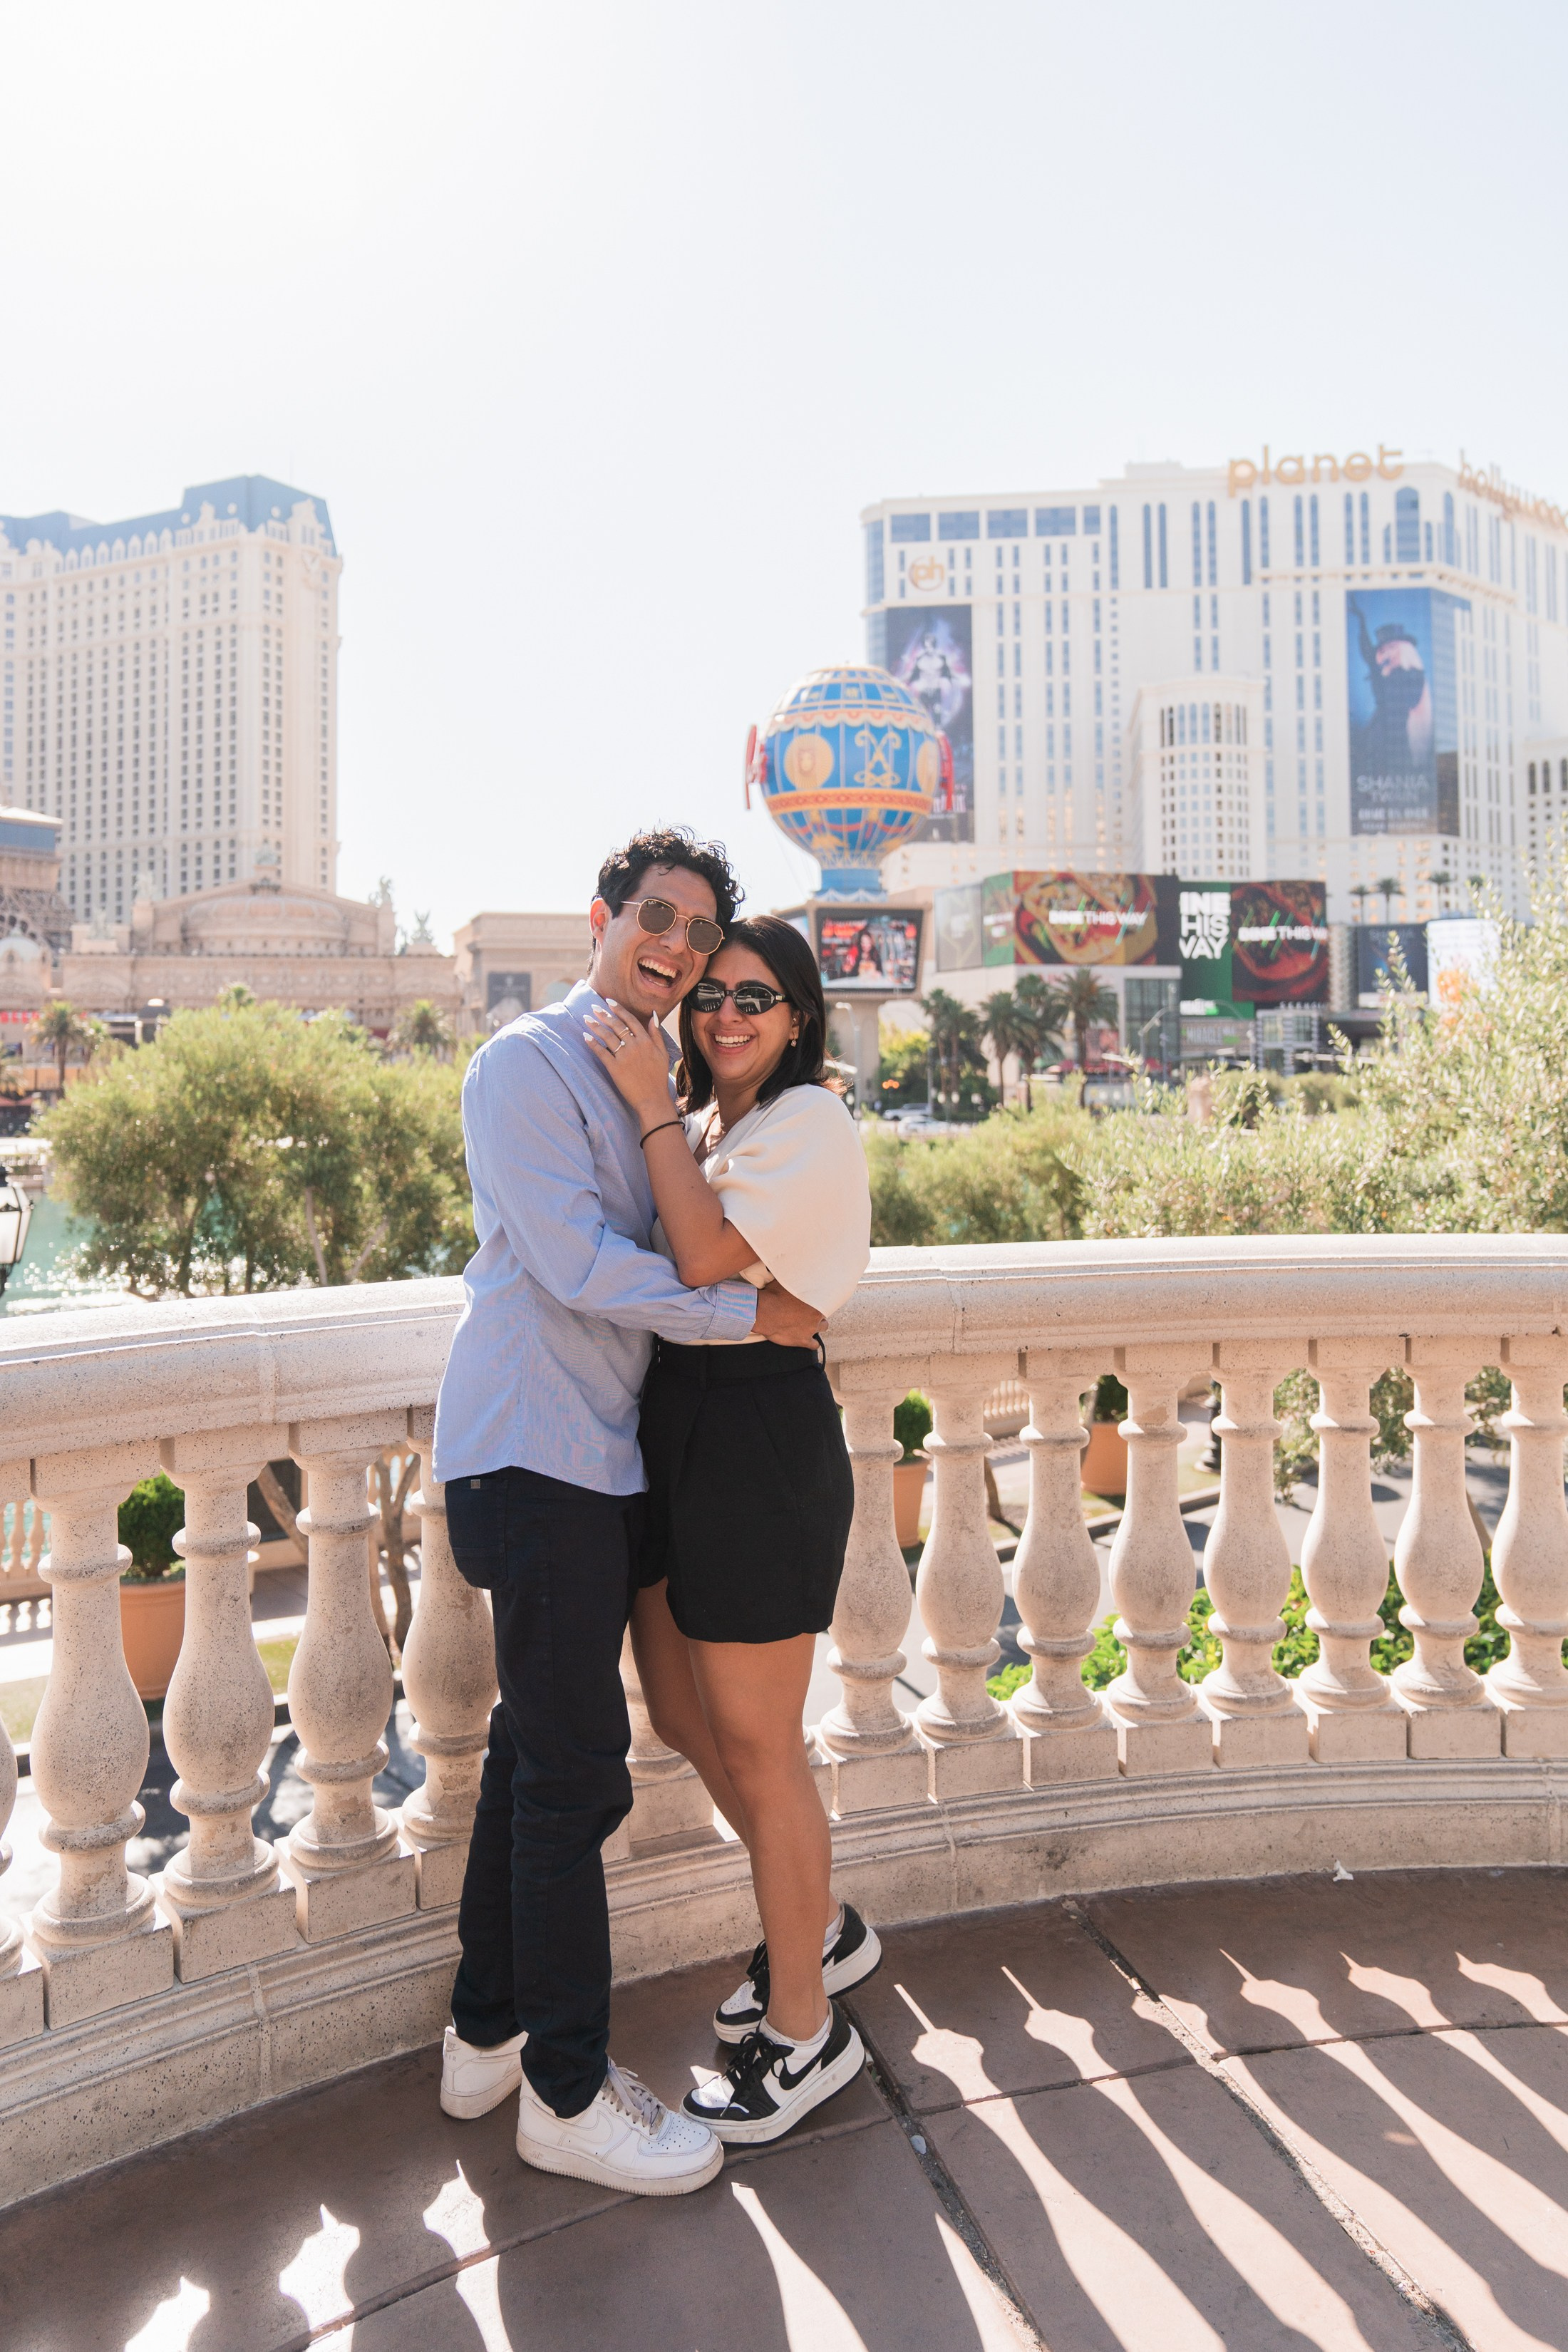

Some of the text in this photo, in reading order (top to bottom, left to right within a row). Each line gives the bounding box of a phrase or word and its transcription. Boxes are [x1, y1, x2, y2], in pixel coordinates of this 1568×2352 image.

[1228, 443, 1568, 533] planet hollywoo
[912, 555, 945, 587] ph
[1179, 892, 1232, 916] INE
[1084, 910, 1117, 925] THIS
[1117, 911, 1149, 925] WAY
[1180, 913, 1230, 938] HIS
[1276, 925, 1311, 940] THIS
